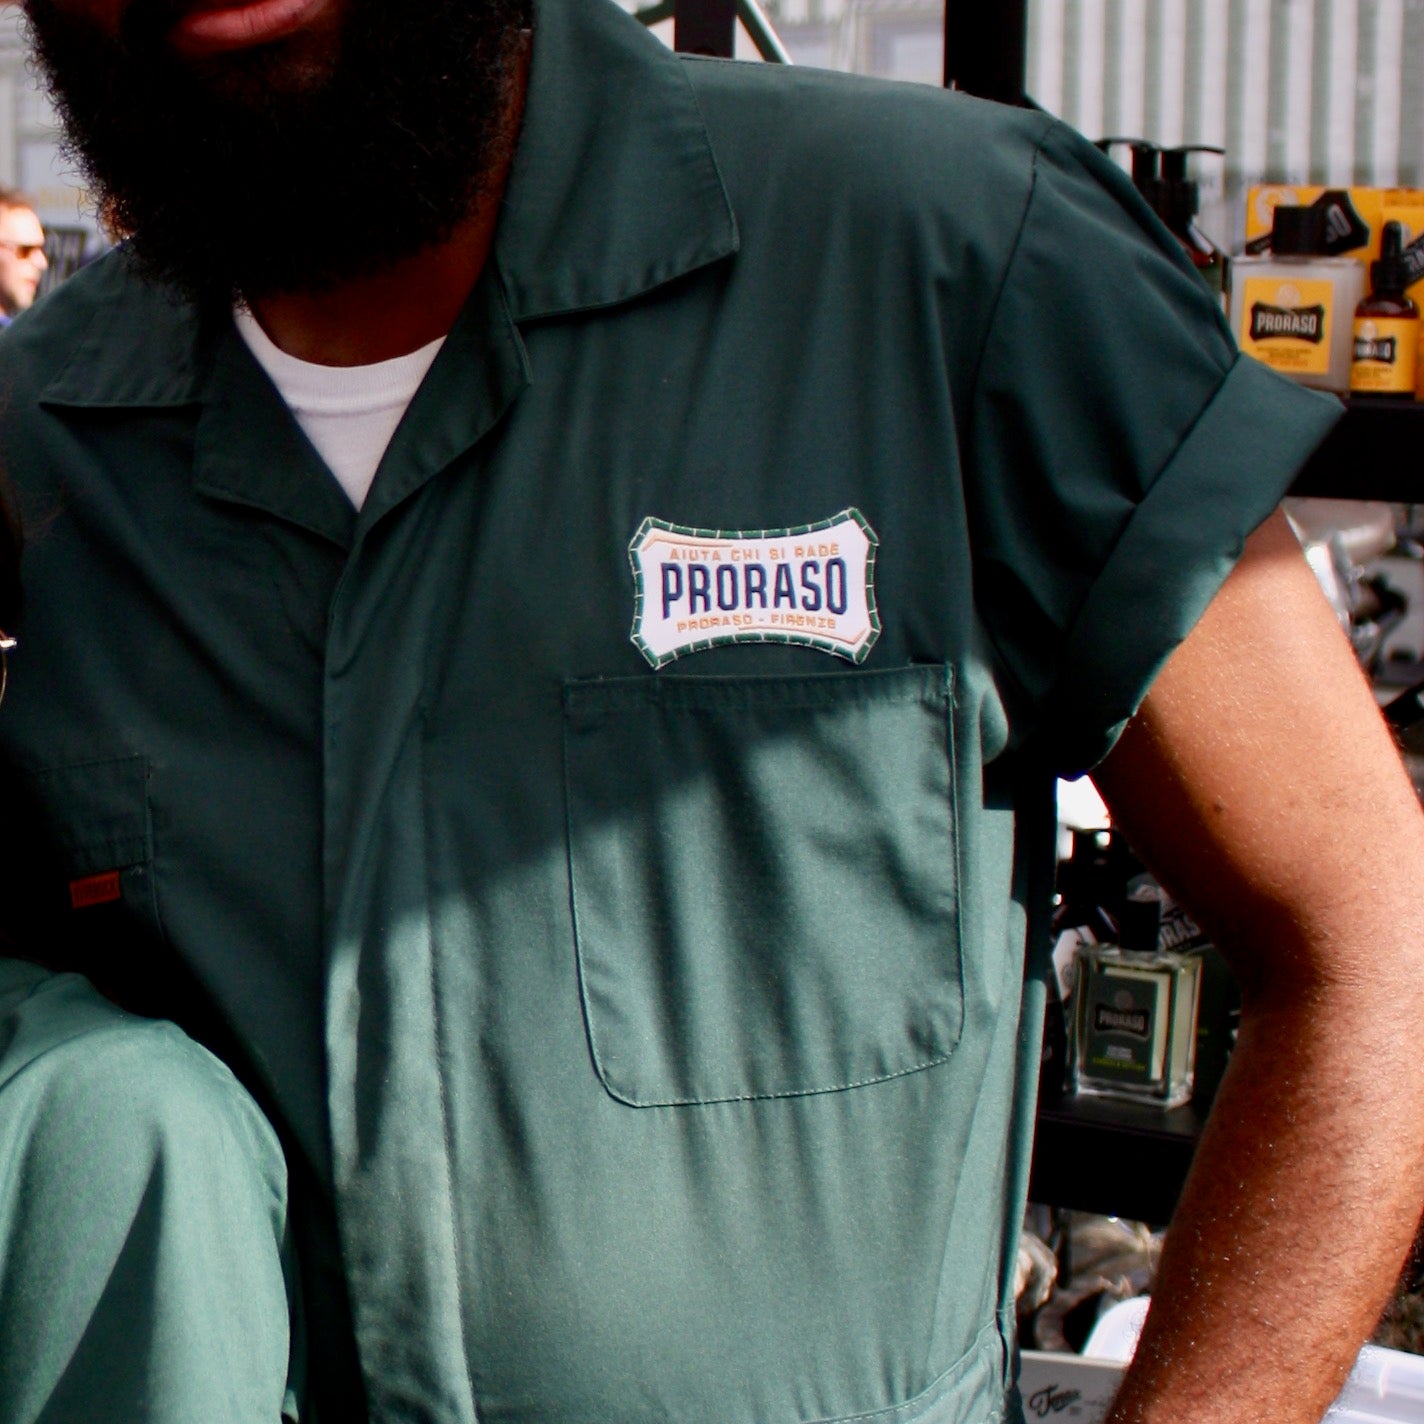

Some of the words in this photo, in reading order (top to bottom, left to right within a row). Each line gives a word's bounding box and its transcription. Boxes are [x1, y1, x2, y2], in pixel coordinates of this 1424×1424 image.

[1256, 311, 1318, 336] PRORASO
[670, 549, 721, 561] AIUTA
[731, 548, 759, 561] CHI
[769, 548, 785, 561] SI
[795, 543, 839, 557] RADE
[661, 558, 847, 619] PRORASO
[678, 614, 752, 632] PRORASO
[771, 614, 836, 628] FIRENZE
